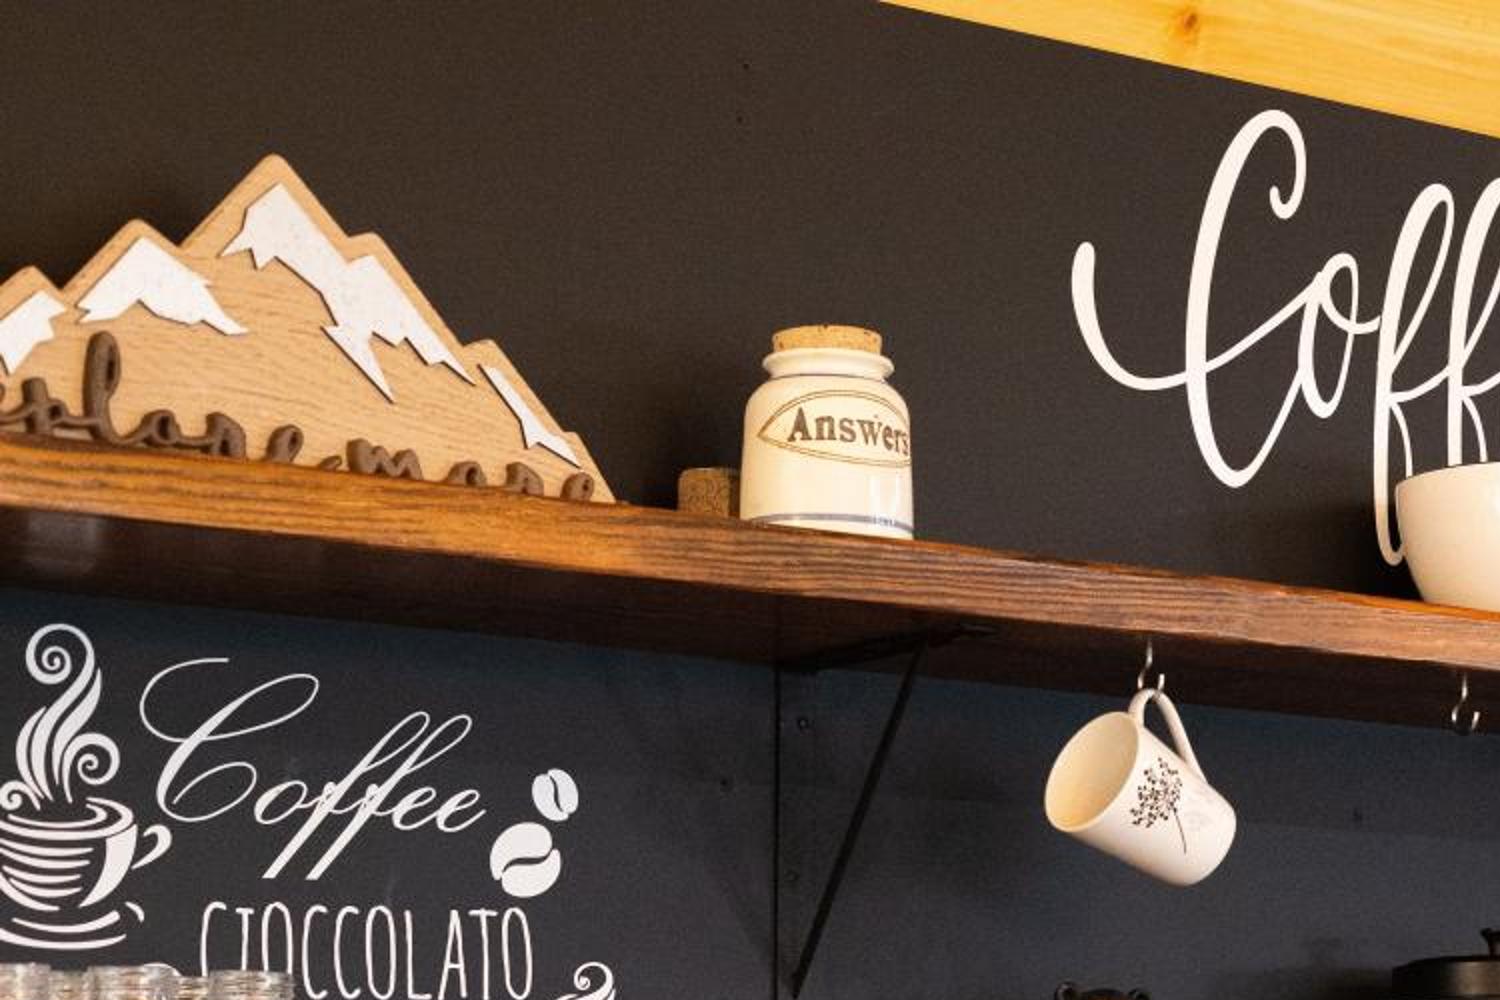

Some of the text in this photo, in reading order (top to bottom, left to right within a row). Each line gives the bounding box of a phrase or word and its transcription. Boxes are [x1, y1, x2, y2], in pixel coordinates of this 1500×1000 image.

[0, 330, 342, 470] plore
[787, 406, 911, 456] Answers
[139, 657, 487, 881] Coffee
